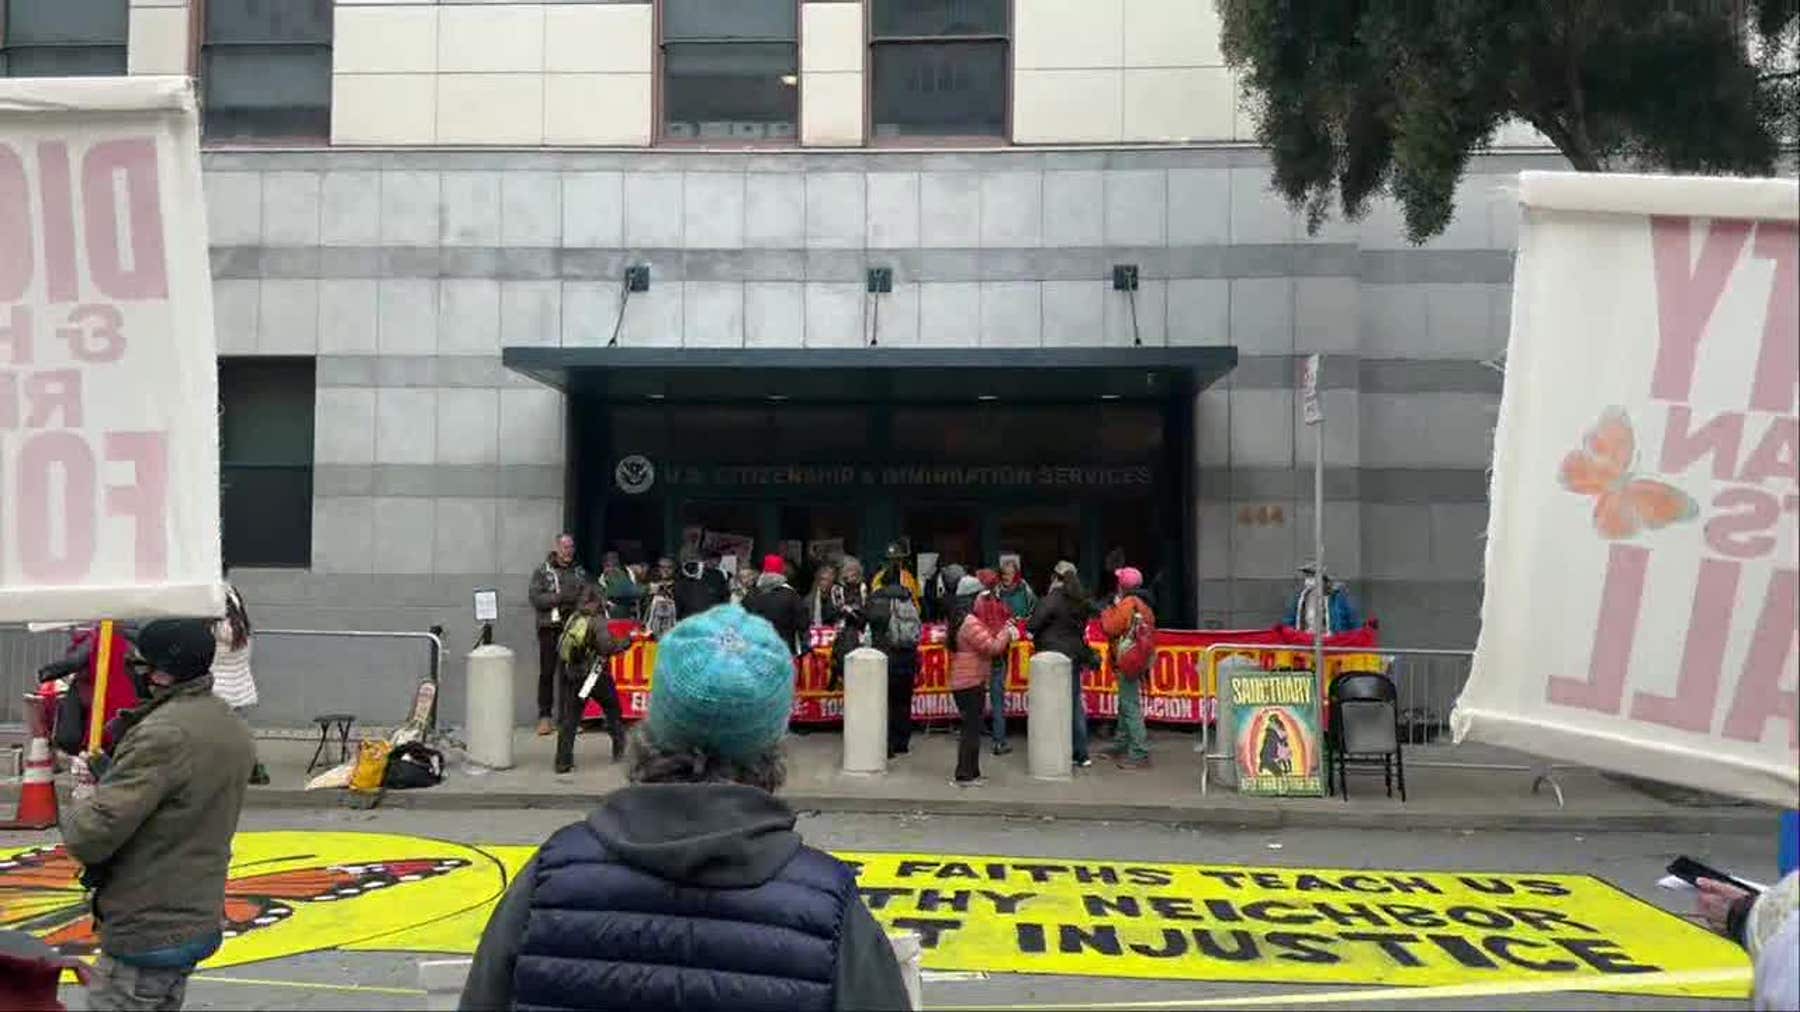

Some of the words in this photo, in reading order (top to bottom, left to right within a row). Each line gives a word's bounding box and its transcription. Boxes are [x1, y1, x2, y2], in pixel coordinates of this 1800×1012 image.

[1038, 464, 1153, 485] SERVICES
[1232, 676, 1311, 704] SANCTUARY
[896, 861, 1172, 886] FAITHS
[1202, 870, 1443, 895] TEACH
[1461, 876, 1572, 896] US
[859, 887, 1038, 914] THY
[1081, 894, 1598, 934] NEIGHBOR
[1016, 922, 1663, 974] INJUSTICE
